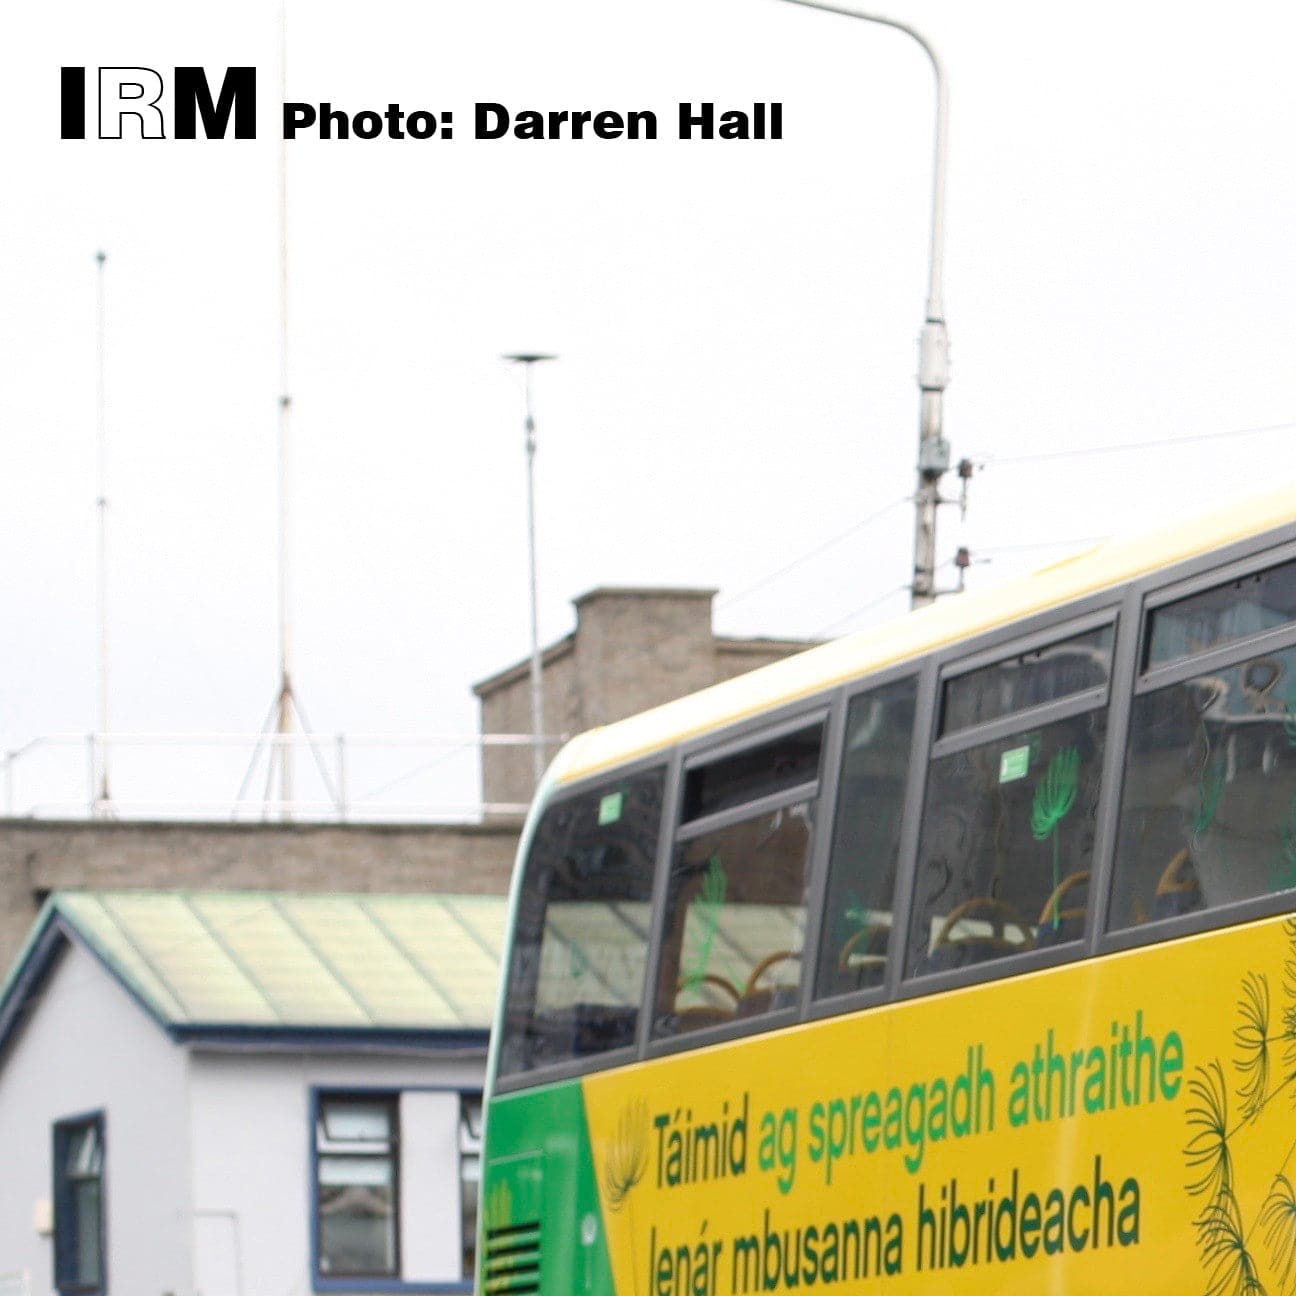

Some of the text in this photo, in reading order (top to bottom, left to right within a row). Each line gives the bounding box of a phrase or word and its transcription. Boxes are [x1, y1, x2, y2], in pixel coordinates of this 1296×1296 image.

[653, 1010, 1185, 1194] Táimid ag spreagadh athraithe
[731, 1209, 903, 1295] mbusanna
[916, 1154, 1140, 1272] hibrideacha
